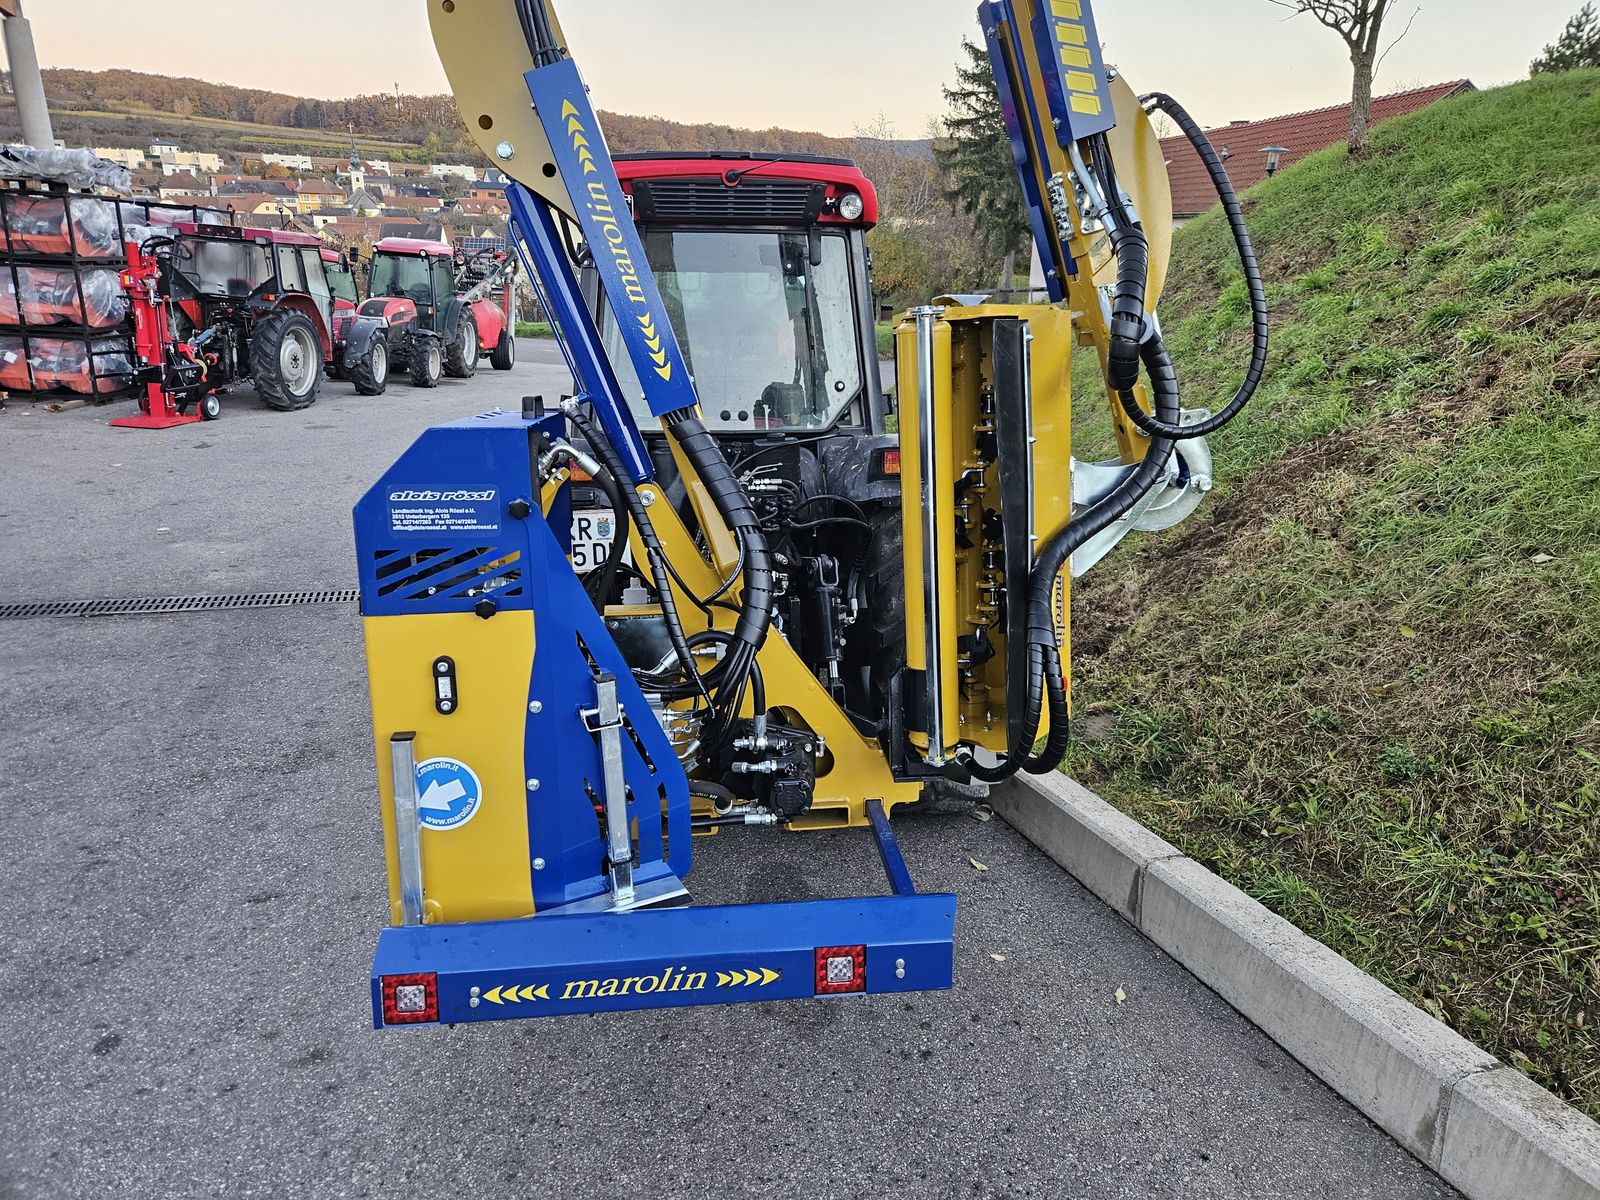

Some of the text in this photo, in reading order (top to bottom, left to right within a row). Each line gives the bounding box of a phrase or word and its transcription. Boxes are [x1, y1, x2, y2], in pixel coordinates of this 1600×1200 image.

[587, 181, 647, 304] marolin
[389, 489, 496, 501] alois rössl
[571, 517, 593, 541] R
[1055, 574, 1066, 648] marolin
[425, 797, 476, 825] www.marolin.it
[559, 965, 708, 1000] marolin
